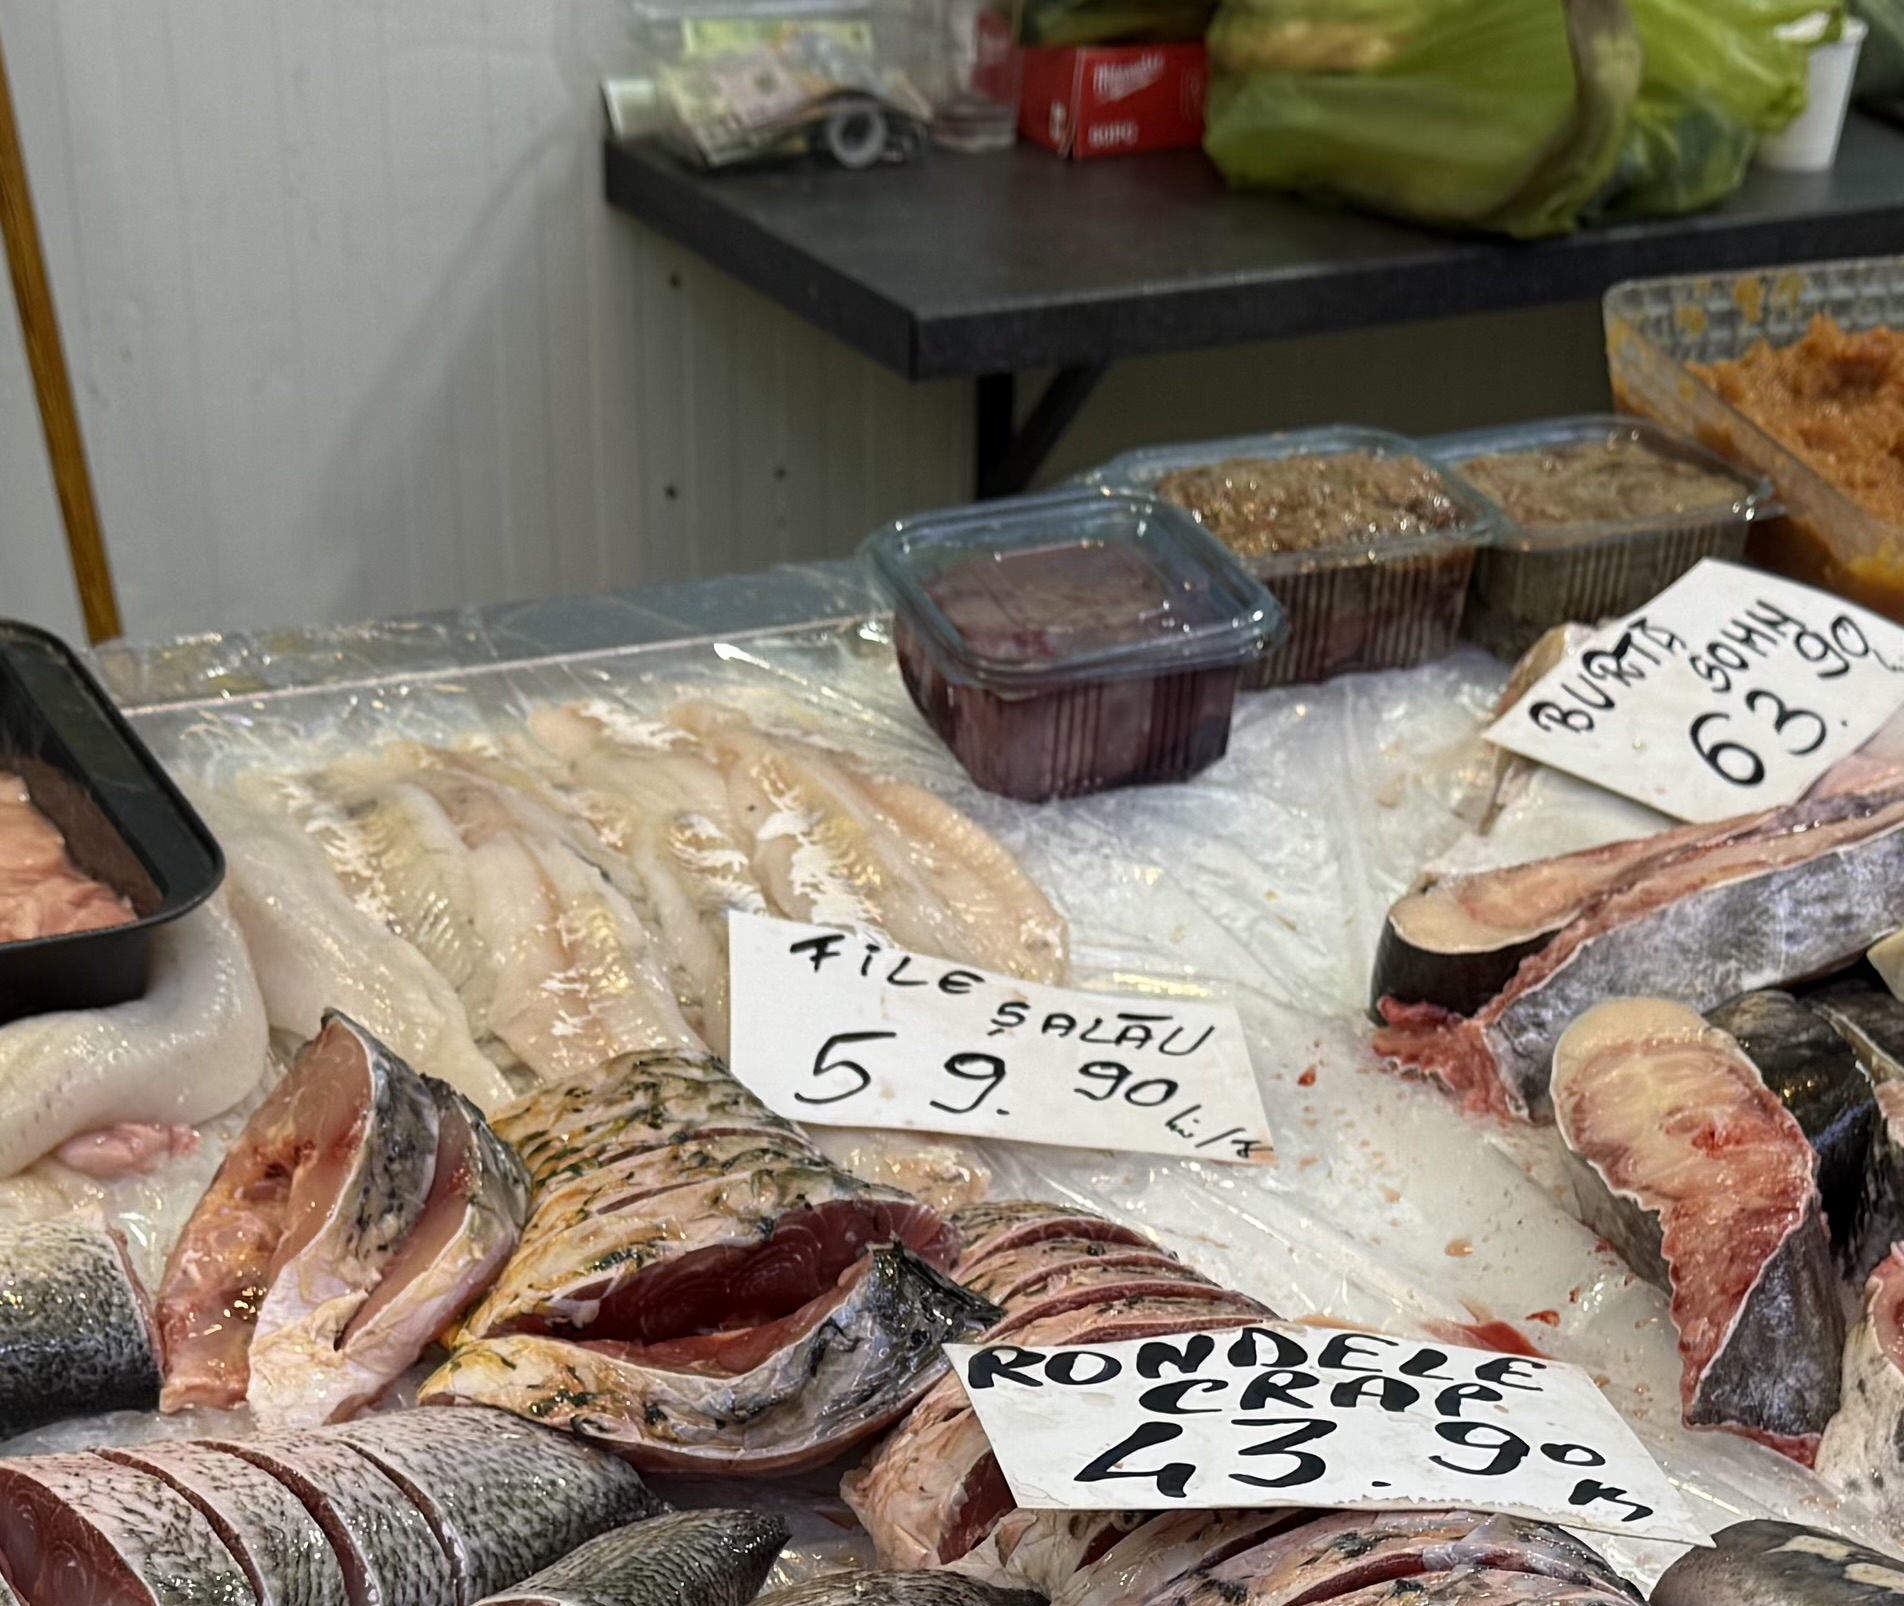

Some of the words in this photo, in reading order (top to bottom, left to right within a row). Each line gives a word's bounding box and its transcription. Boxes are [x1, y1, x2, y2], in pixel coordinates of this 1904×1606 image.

[1528, 617, 1686, 734] BURTA
[967, 1327, 1549, 1392] RONDELE
[1138, 1370, 1506, 1417] CRAP
